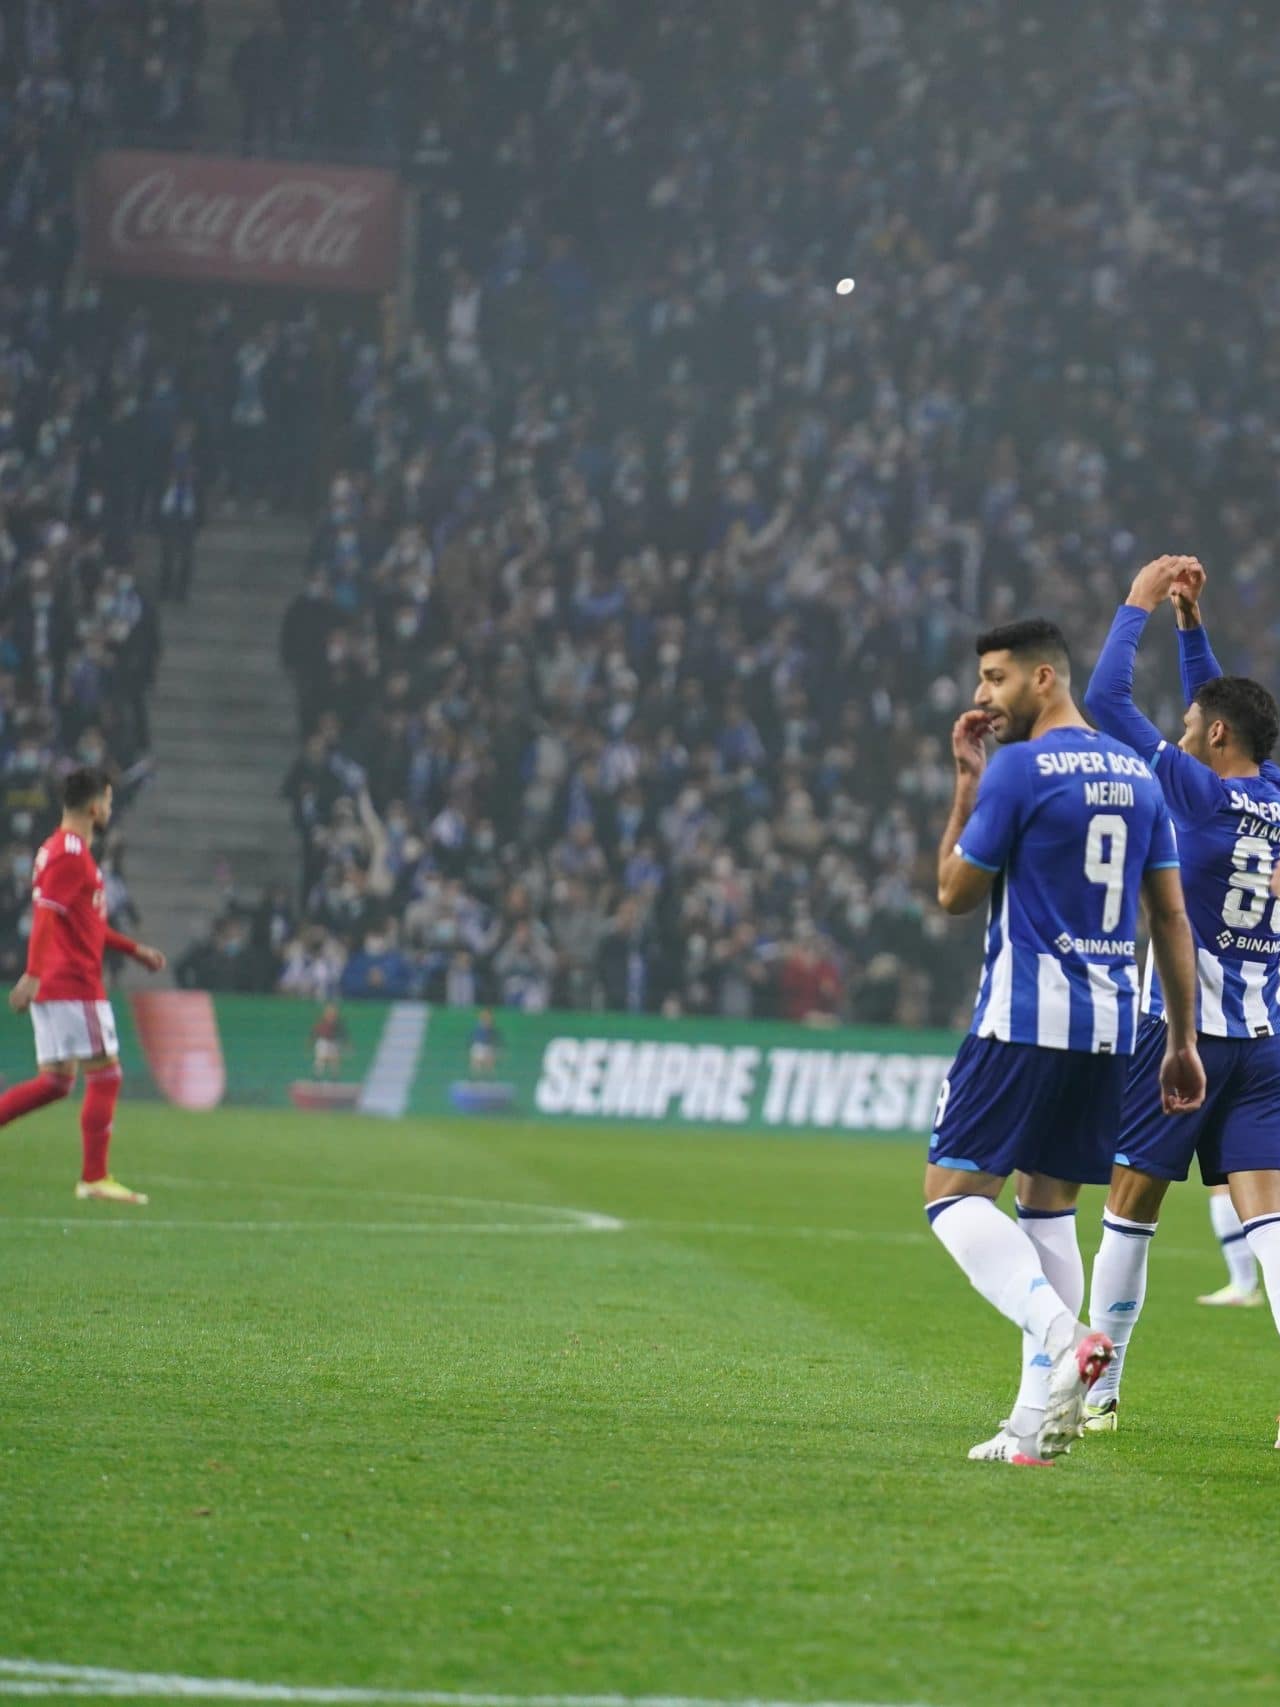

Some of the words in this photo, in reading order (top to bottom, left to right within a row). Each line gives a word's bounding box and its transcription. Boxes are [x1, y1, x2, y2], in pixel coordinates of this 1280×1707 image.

[1036, 752, 1107, 775] SUPER
[1084, 782, 1134, 807] MEHDI
[1085, 814, 1127, 933] 9
[1074, 938, 1135, 956] BINANCE
[535, 1037, 761, 1122] SEMPRE
[762, 1047, 956, 1132] TIVEST
